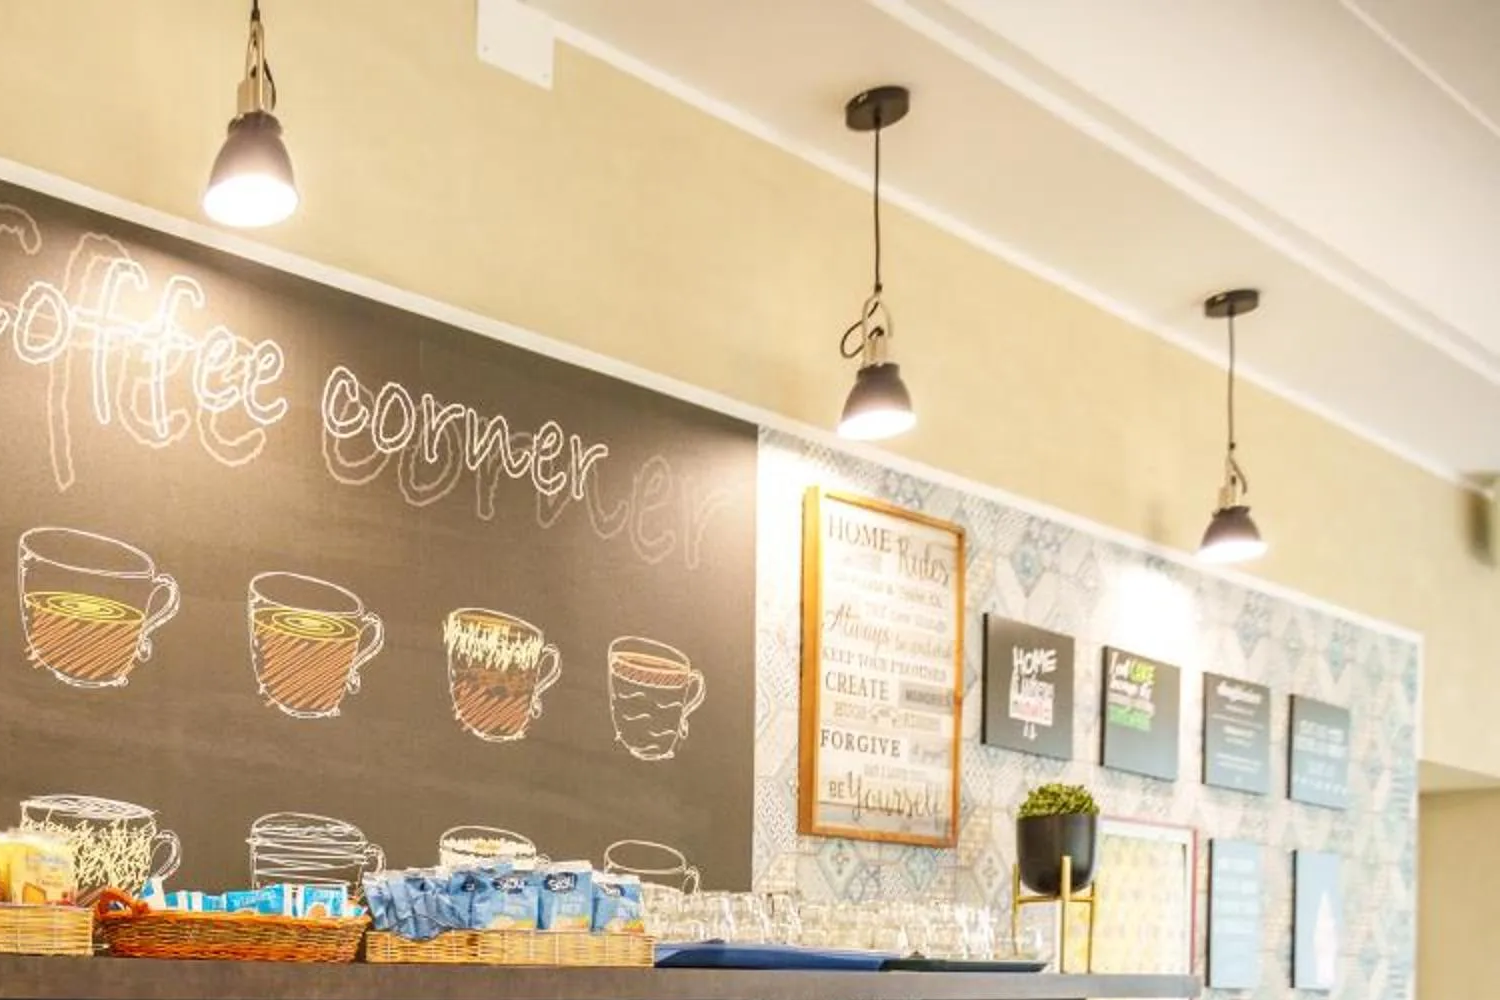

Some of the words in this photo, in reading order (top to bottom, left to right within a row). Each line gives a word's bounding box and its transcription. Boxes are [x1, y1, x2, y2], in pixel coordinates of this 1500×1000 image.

[321, 365, 609, 500] corner
[828, 513, 893, 553] HOME
[825, 670, 889, 701] CREATE
[820, 728, 901, 759] FORGIVE
